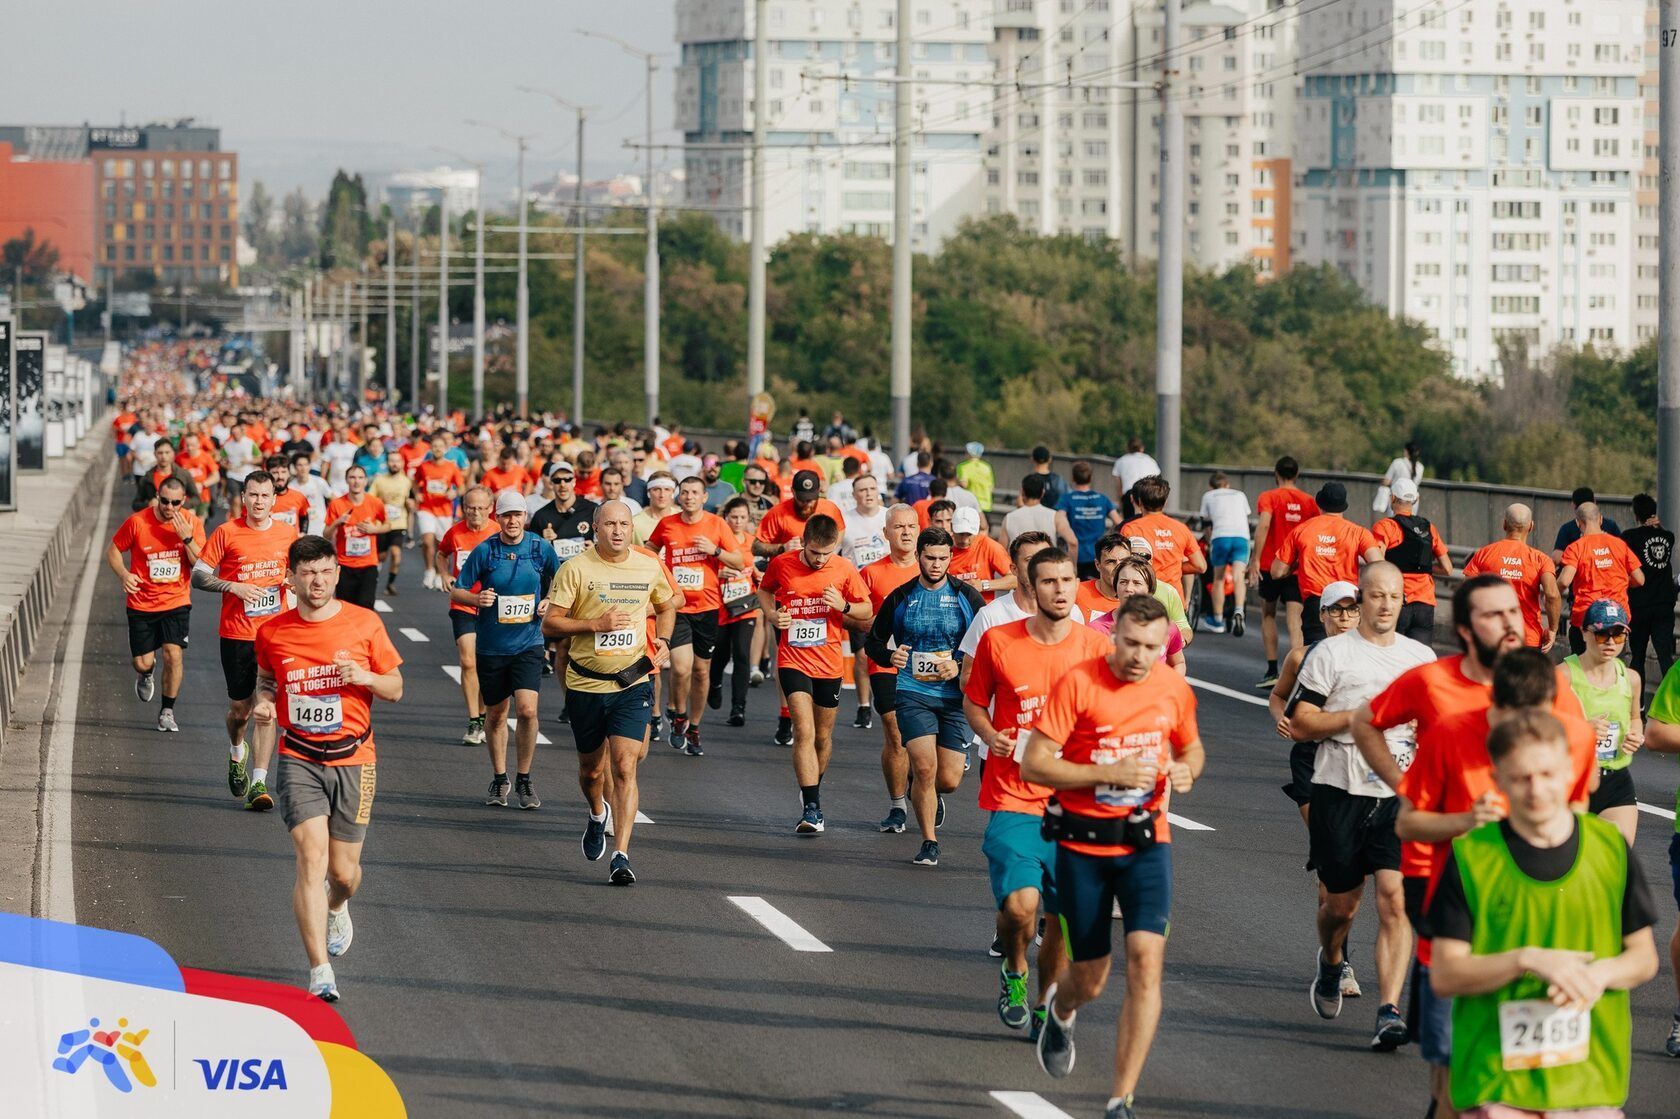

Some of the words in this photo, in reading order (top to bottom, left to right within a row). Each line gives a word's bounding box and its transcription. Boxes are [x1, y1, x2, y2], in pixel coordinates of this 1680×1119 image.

[1662, 29, 1678, 47] 97
[1318, 535, 1336, 543] VISA
[561, 545, 580, 554] 1510
[860, 551, 881, 562] 1435
[1502, 556, 1522, 565] VISA
[153, 567, 177, 577] 2987
[241, 563, 254, 572] OUR
[255, 560, 279, 569] HEARTS
[677, 574, 700, 584] 2501
[791, 598, 803, 607] OUR
[804, 596, 826, 606] HEART
[504, 603, 530, 616] 3176
[796, 627, 821, 639] 1351
[599, 633, 633, 647] 2390
[287, 668, 305, 682] OUR
[1020, 696, 1039, 712] OUR
[295, 707, 334, 723] 1488
[1016, 710, 1033, 725] RUN
